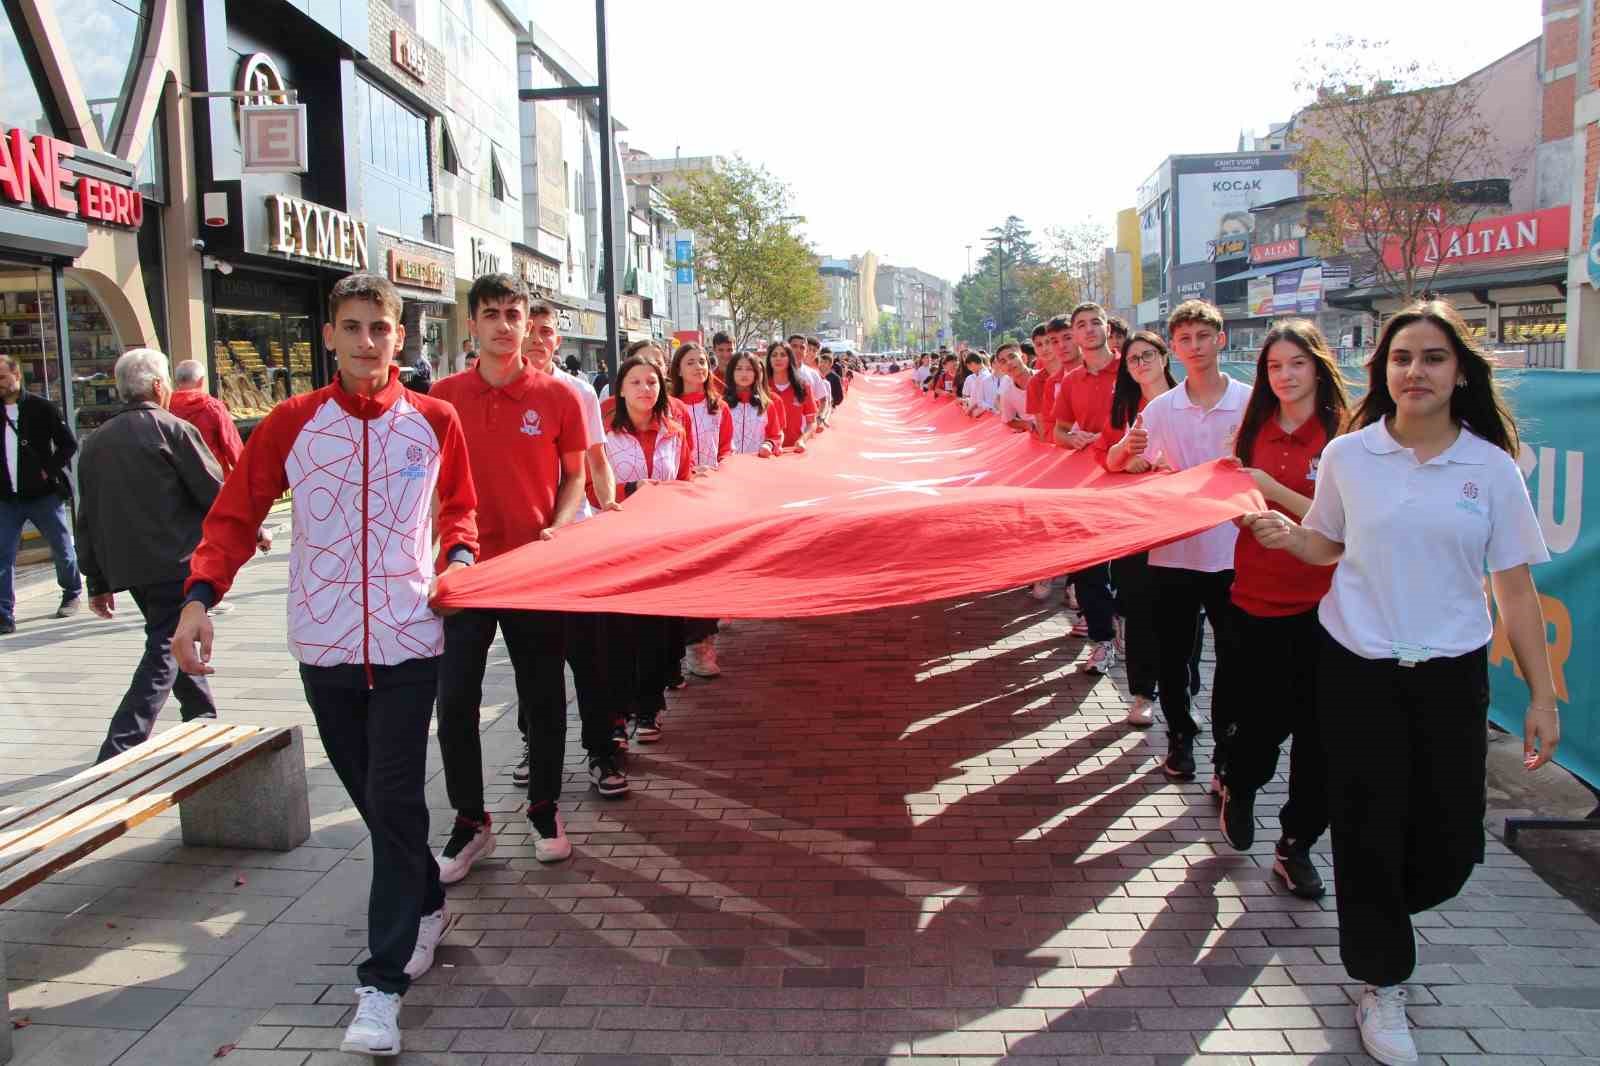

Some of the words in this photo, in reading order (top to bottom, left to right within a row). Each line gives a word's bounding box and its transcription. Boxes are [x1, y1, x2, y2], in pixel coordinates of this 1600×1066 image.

[80, 177, 143, 228] EBRU
[275, 193, 368, 270] EYMEN
[1263, 240, 1297, 257] ALTAN
[1446, 219, 1538, 258] ALTAN
[1517, 304, 1553, 319] ALTAN
